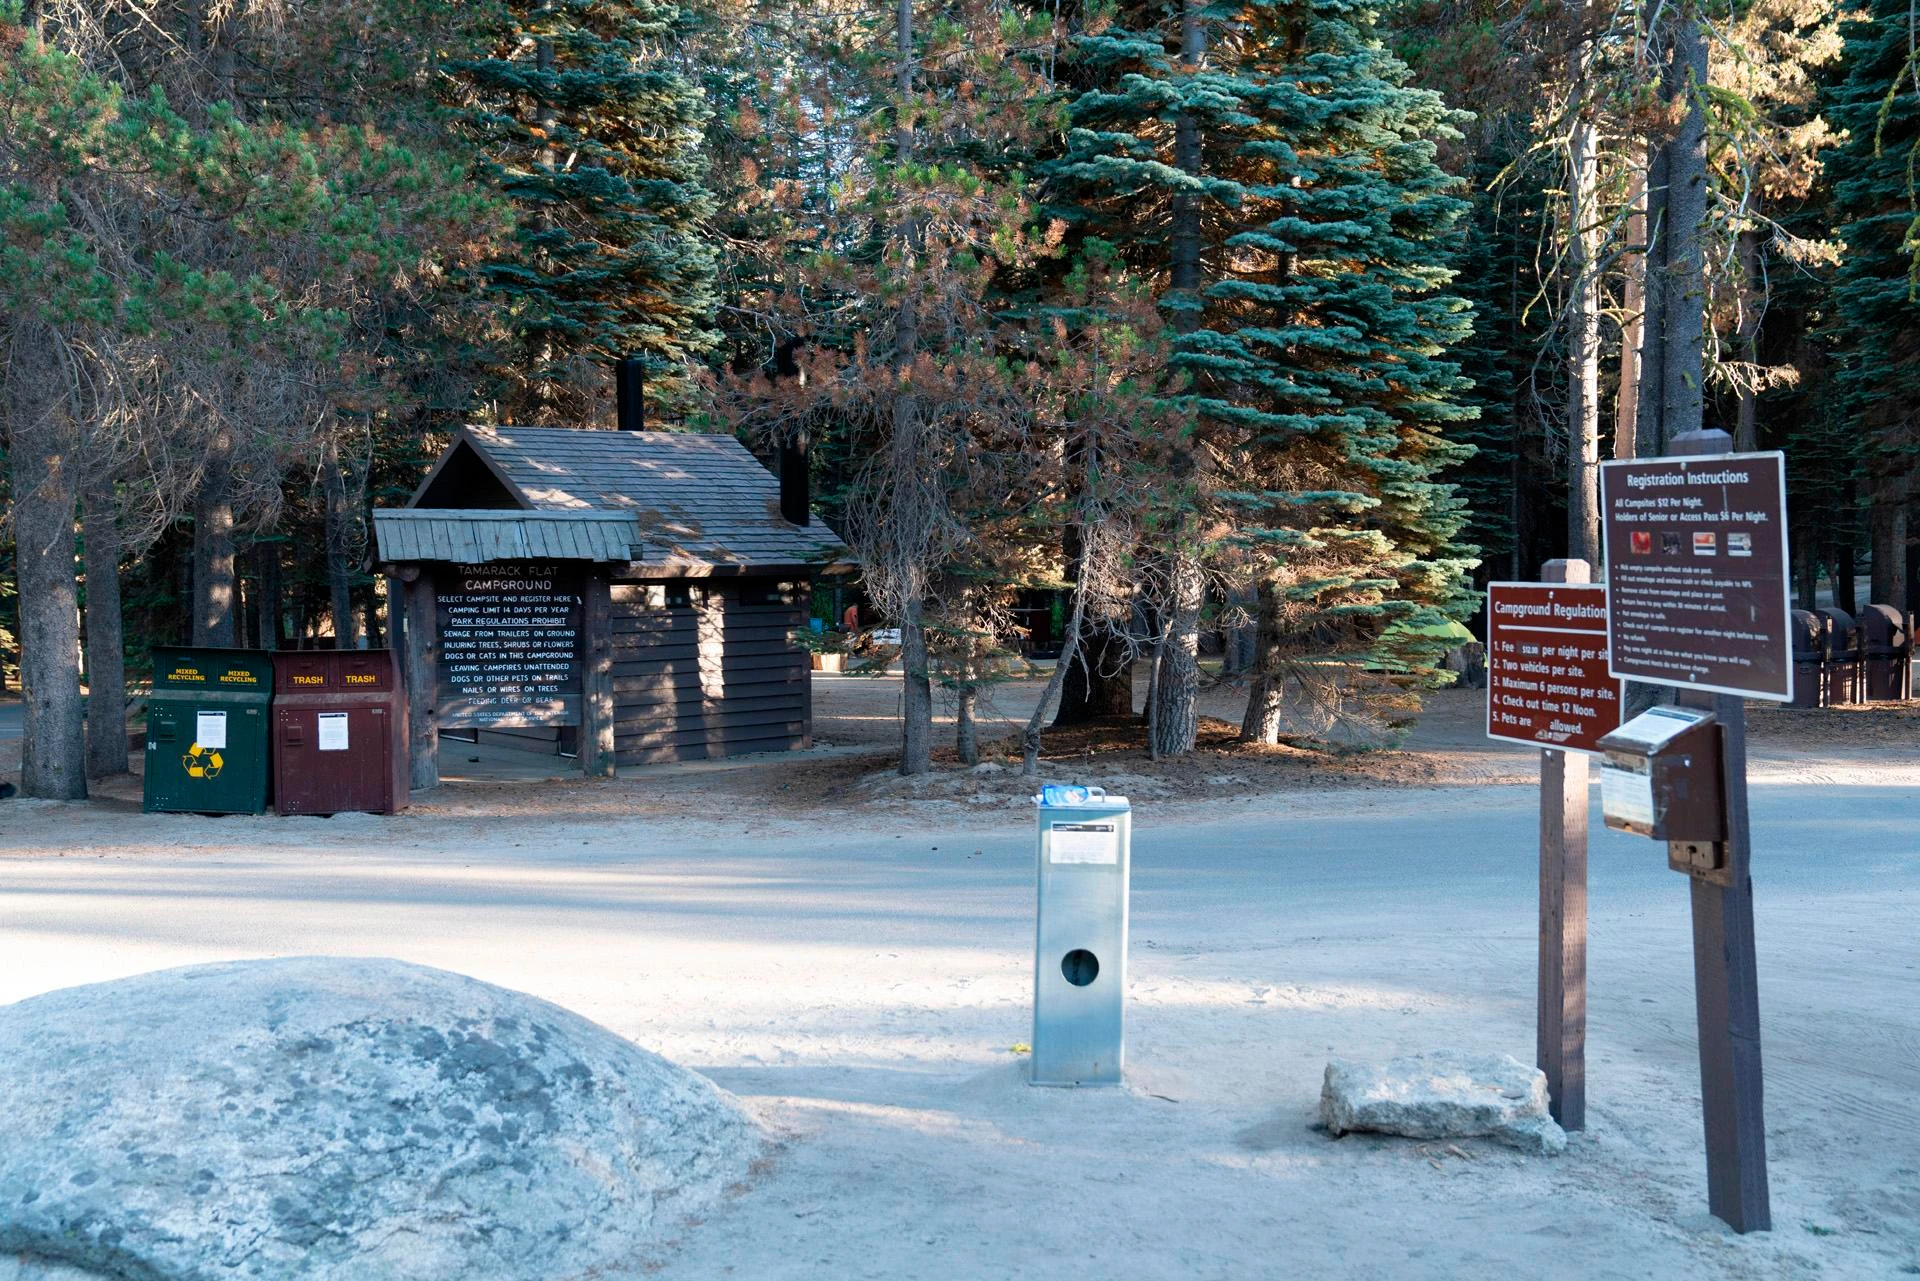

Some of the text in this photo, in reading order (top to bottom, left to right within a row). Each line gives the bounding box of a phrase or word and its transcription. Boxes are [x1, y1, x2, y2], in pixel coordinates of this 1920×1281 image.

[1627, 469, 1749, 490] Registration Instructions
[1615, 496, 1704, 509] All Campsites $12 Per Night.
[1615, 512, 1638, 521] Holders
[1639, 512, 1647, 521] of
[1648, 512, 1668, 521] Senior
[1670, 513, 1678, 521] or
[1679, 512, 1702, 521] Access
[1703, 511, 1718, 521] Pass
[1731, 511, 1743, 520] Per
[1745, 511, 1768, 524] Night.
[458, 566, 559, 576] TAMARACK FLAT
[465, 580, 552, 590] CAMPGROUND
[437, 595, 463, 603] SELECT
[466, 595, 500, 603] CAMPSITE
[502, 595, 518, 603] AND
[520, 595, 551, 603] REGISTER
[448, 606, 480, 614] CAMPING
[482, 606, 501, 614] LIMIT
[1494, 601, 1606, 620] Campground Regulation
[451, 617, 566, 625] PARK REGULATIONS PROHIBIT
[443, 630, 471, 638] SEWAGE
[444, 641, 477, 649] INJURING
[503, 641, 531, 649] SHRUBS
[1494, 641, 1500, 652] 1.
[1501, 641, 1514, 652] Fee
[1541, 646, 1555, 657] per
[1558, 645, 1579, 660] night
[1581, 649, 1595, 661] per
[1598, 648, 1609, 660] sit
[445, 652, 464, 660] DOGS
[450, 664, 480, 672] LEAVING
[1493, 658, 1585, 677] 2. Two vehicles per site.
[293, 676, 324, 684] TRASH
[345, 675, 376, 683] TRASH
[451, 675, 471, 683] DOGS
[511, 674, 529, 682] PETS
[462, 686, 483, 694] NAILS
[1493, 676, 1616, 700] 3. Maximum 6 persons per site.
[468, 697, 497, 705] FEEDING
[1493, 693, 1597, 717] 4. Check out time 12 Noon.
[1492, 711, 1584, 735] 5. Pets are allowed.
